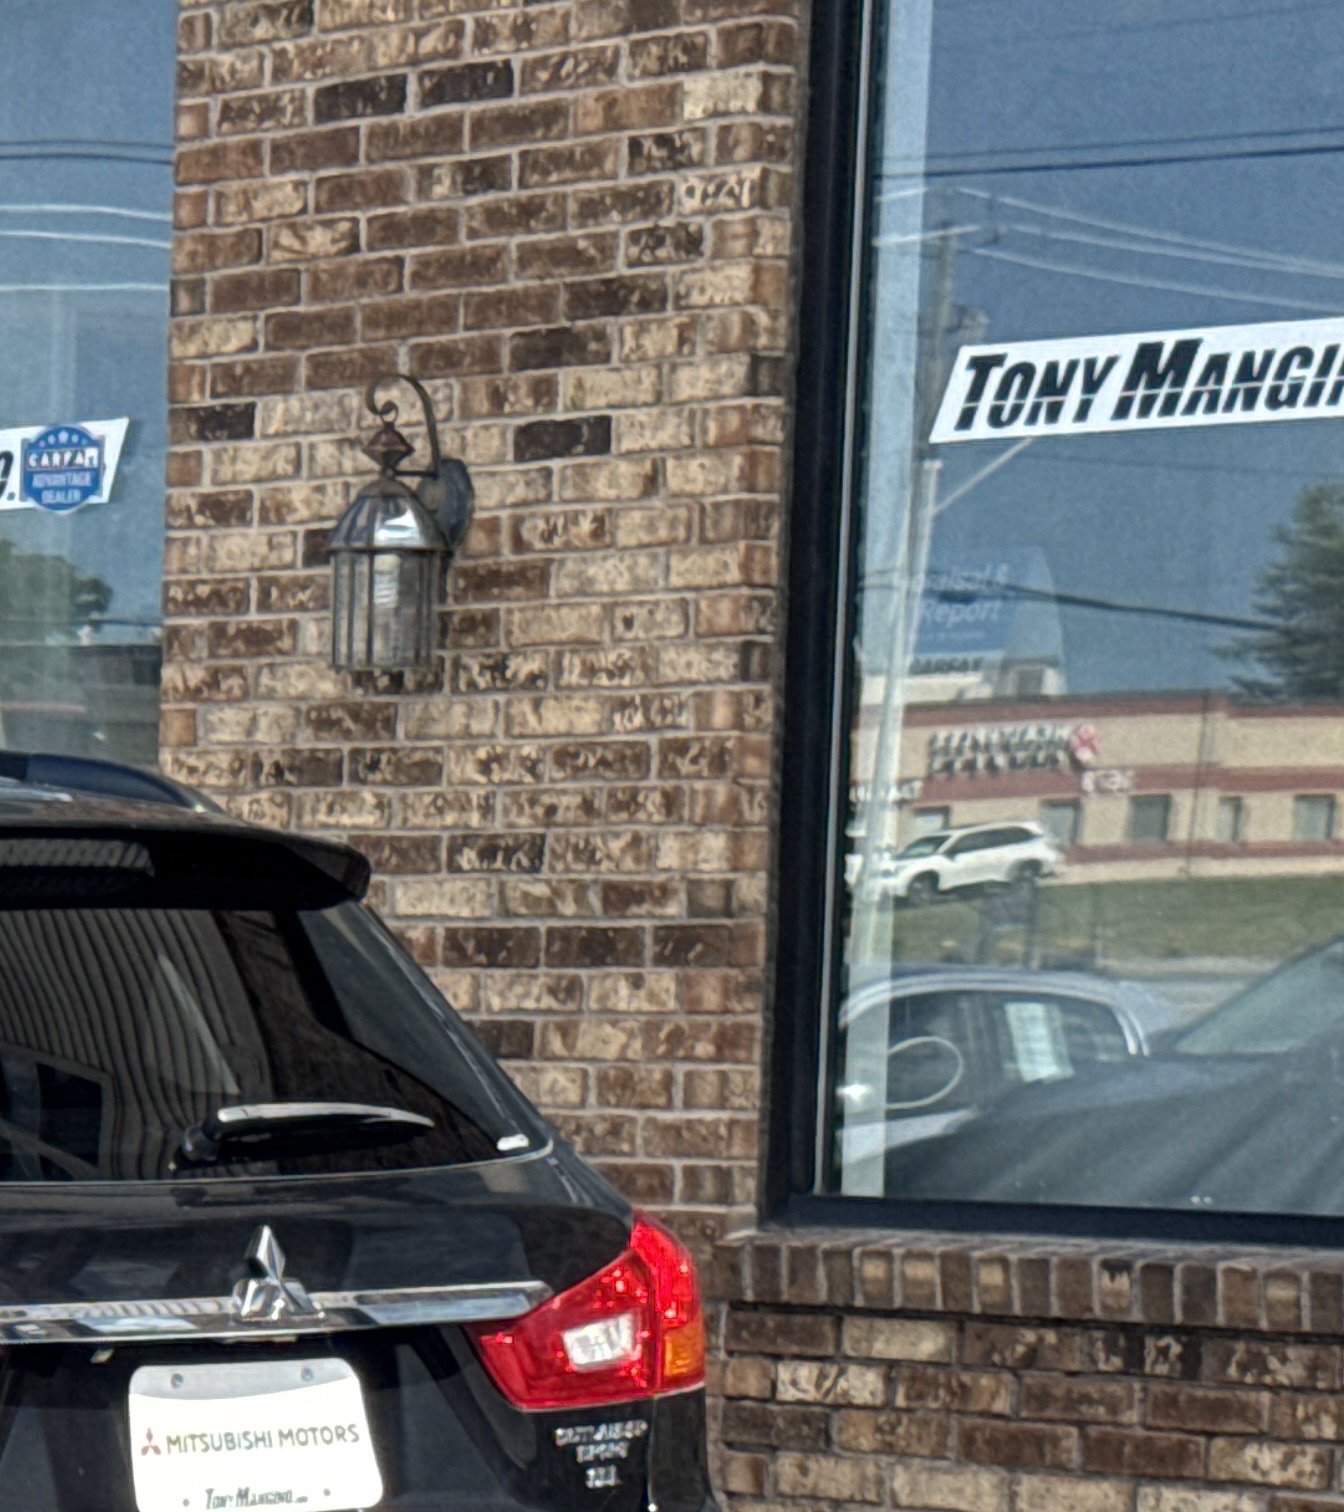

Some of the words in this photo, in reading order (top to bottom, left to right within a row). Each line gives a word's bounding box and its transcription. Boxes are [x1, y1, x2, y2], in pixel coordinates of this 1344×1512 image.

[953, 352, 1120, 432] TONY
[166, 1430, 273, 1455] MITSUBISHI
[278, 1424, 360, 1448] MOTORS
